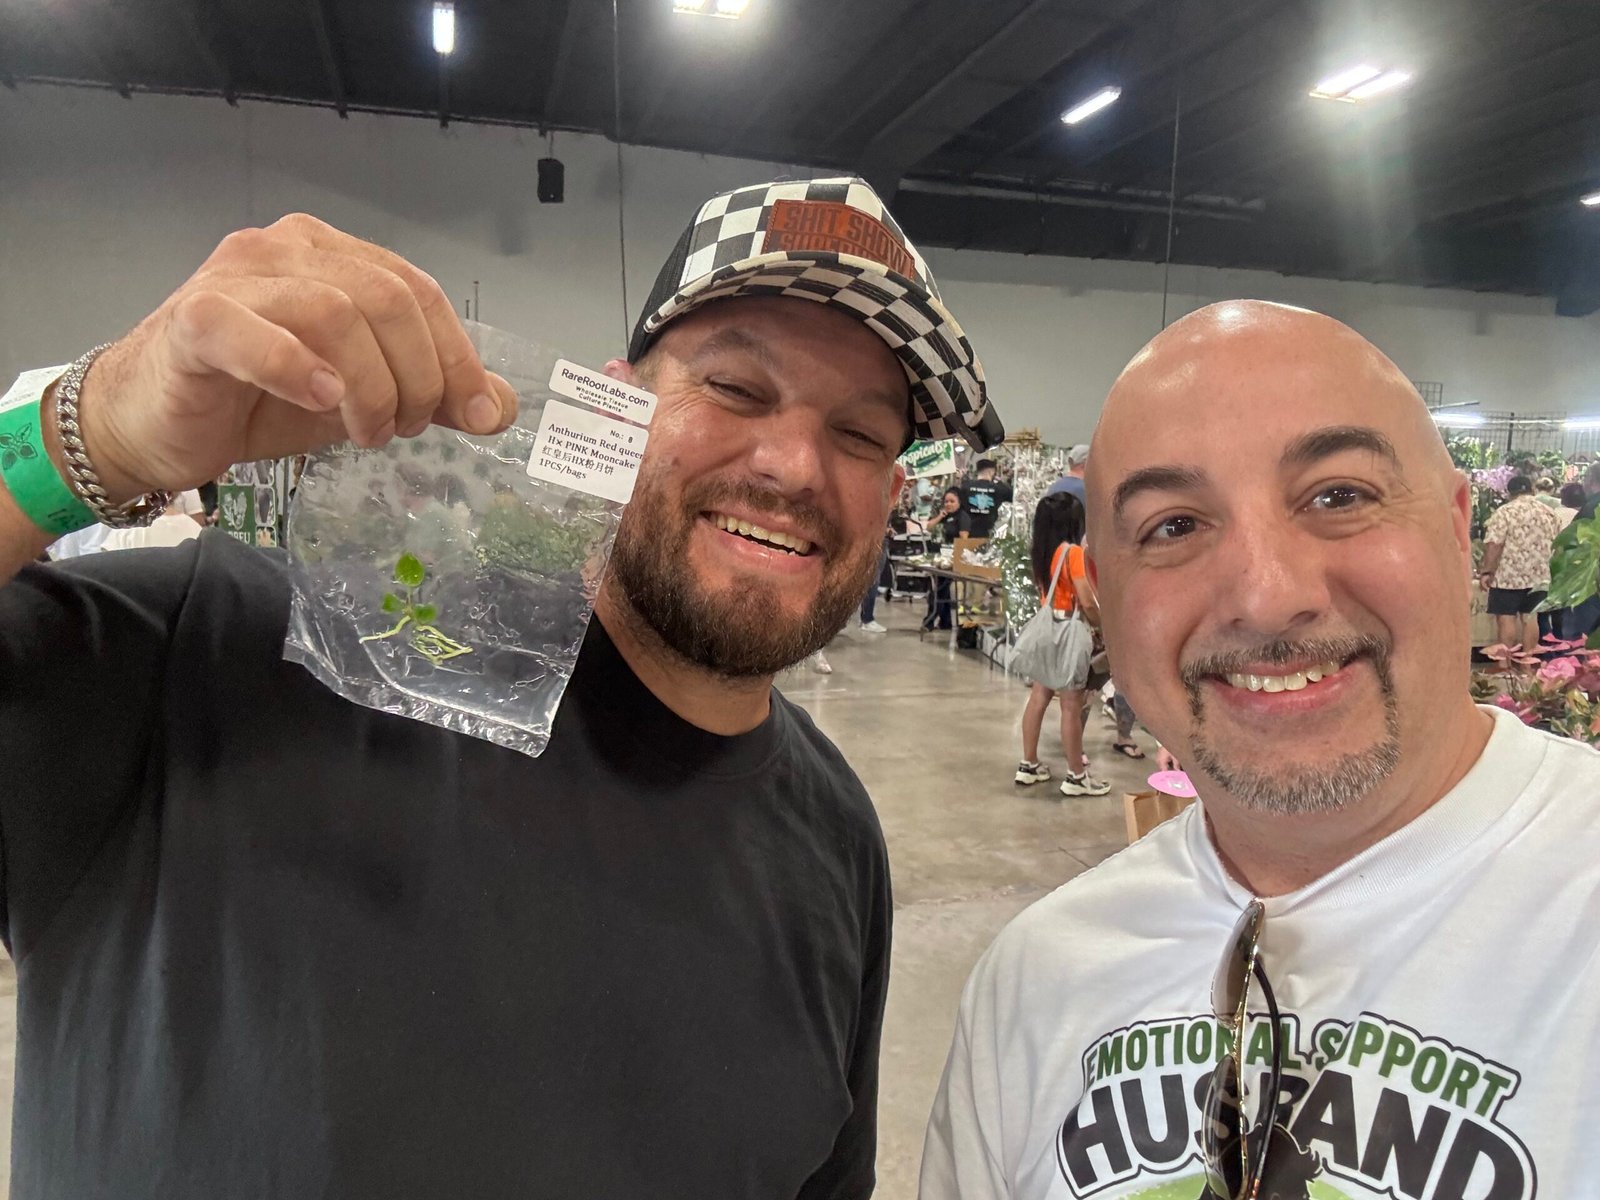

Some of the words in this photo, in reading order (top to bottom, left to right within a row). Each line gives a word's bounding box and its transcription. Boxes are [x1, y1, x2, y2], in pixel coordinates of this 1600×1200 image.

[784, 206, 842, 234] SHIT
[847, 213, 908, 273] SHOW
[561, 368, 649, 408] RareRootLabs.com
[576, 386, 607, 402] Wholesale
[609, 397, 628, 409] Tissue
[579, 393, 601, 405] Culture
[602, 401, 621, 412] Plants
[548, 423, 597, 445] Anthurium
[600, 439, 618, 452] Red
[539, 458, 587, 480] 1PCS/bags
[565, 440, 589, 456] PINK
[590, 448, 636, 470] Mooncake
[1086, 1020, 1302, 1088] EMOTIONAL
[1315, 1020, 1512, 1118] SPPORT
